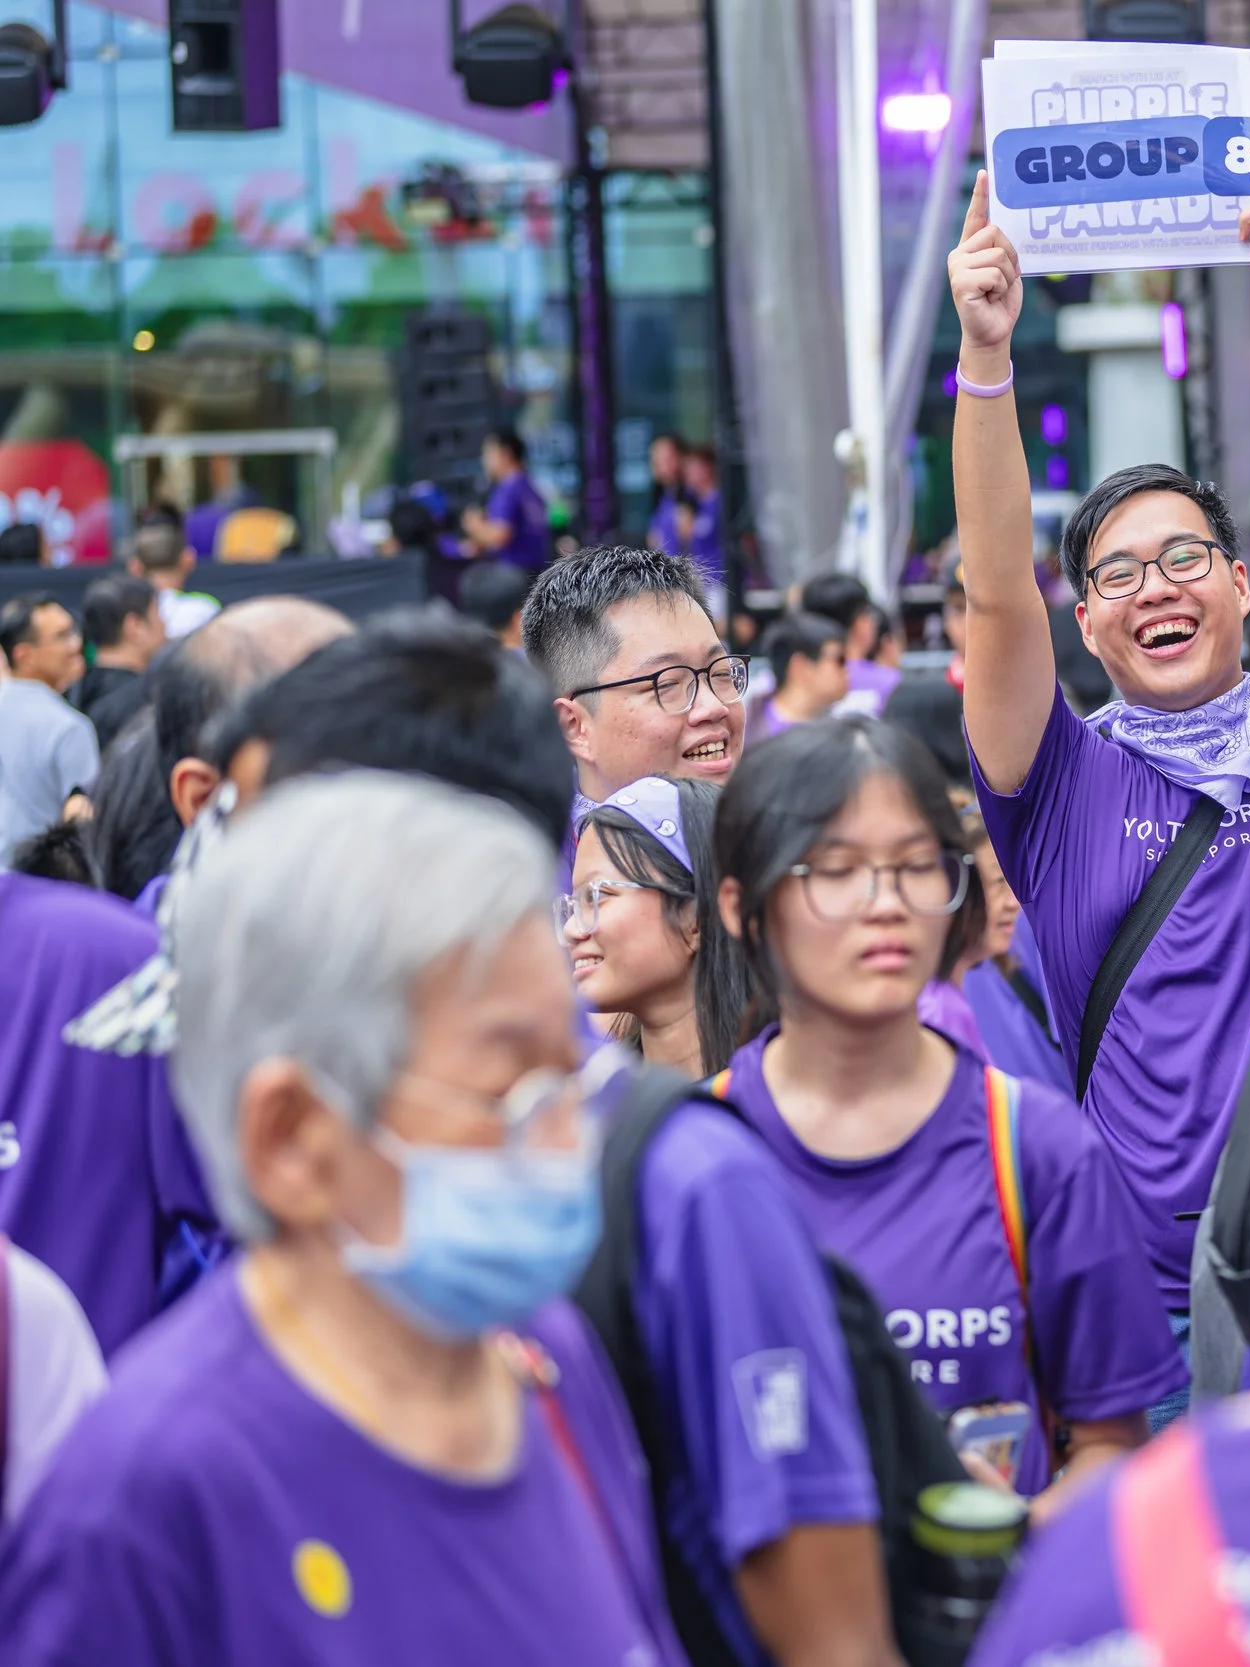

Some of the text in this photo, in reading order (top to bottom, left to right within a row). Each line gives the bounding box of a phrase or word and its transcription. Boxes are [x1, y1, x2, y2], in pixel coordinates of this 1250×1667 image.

[1121, 72, 1148, 83] WITH
[1031, 82, 1228, 127] PURPLE
[1015, 136, 1199, 184] GROUP
[1024, 244, 1039, 254] TO
[1040, 242, 1090, 254] SUPPORT
[1141, 238, 1169, 250] WITH
[1170, 236, 1213, 248] SPECIAL
[884, 1305, 1012, 1349] ORPS
[910, 1359, 961, 1384] RE
